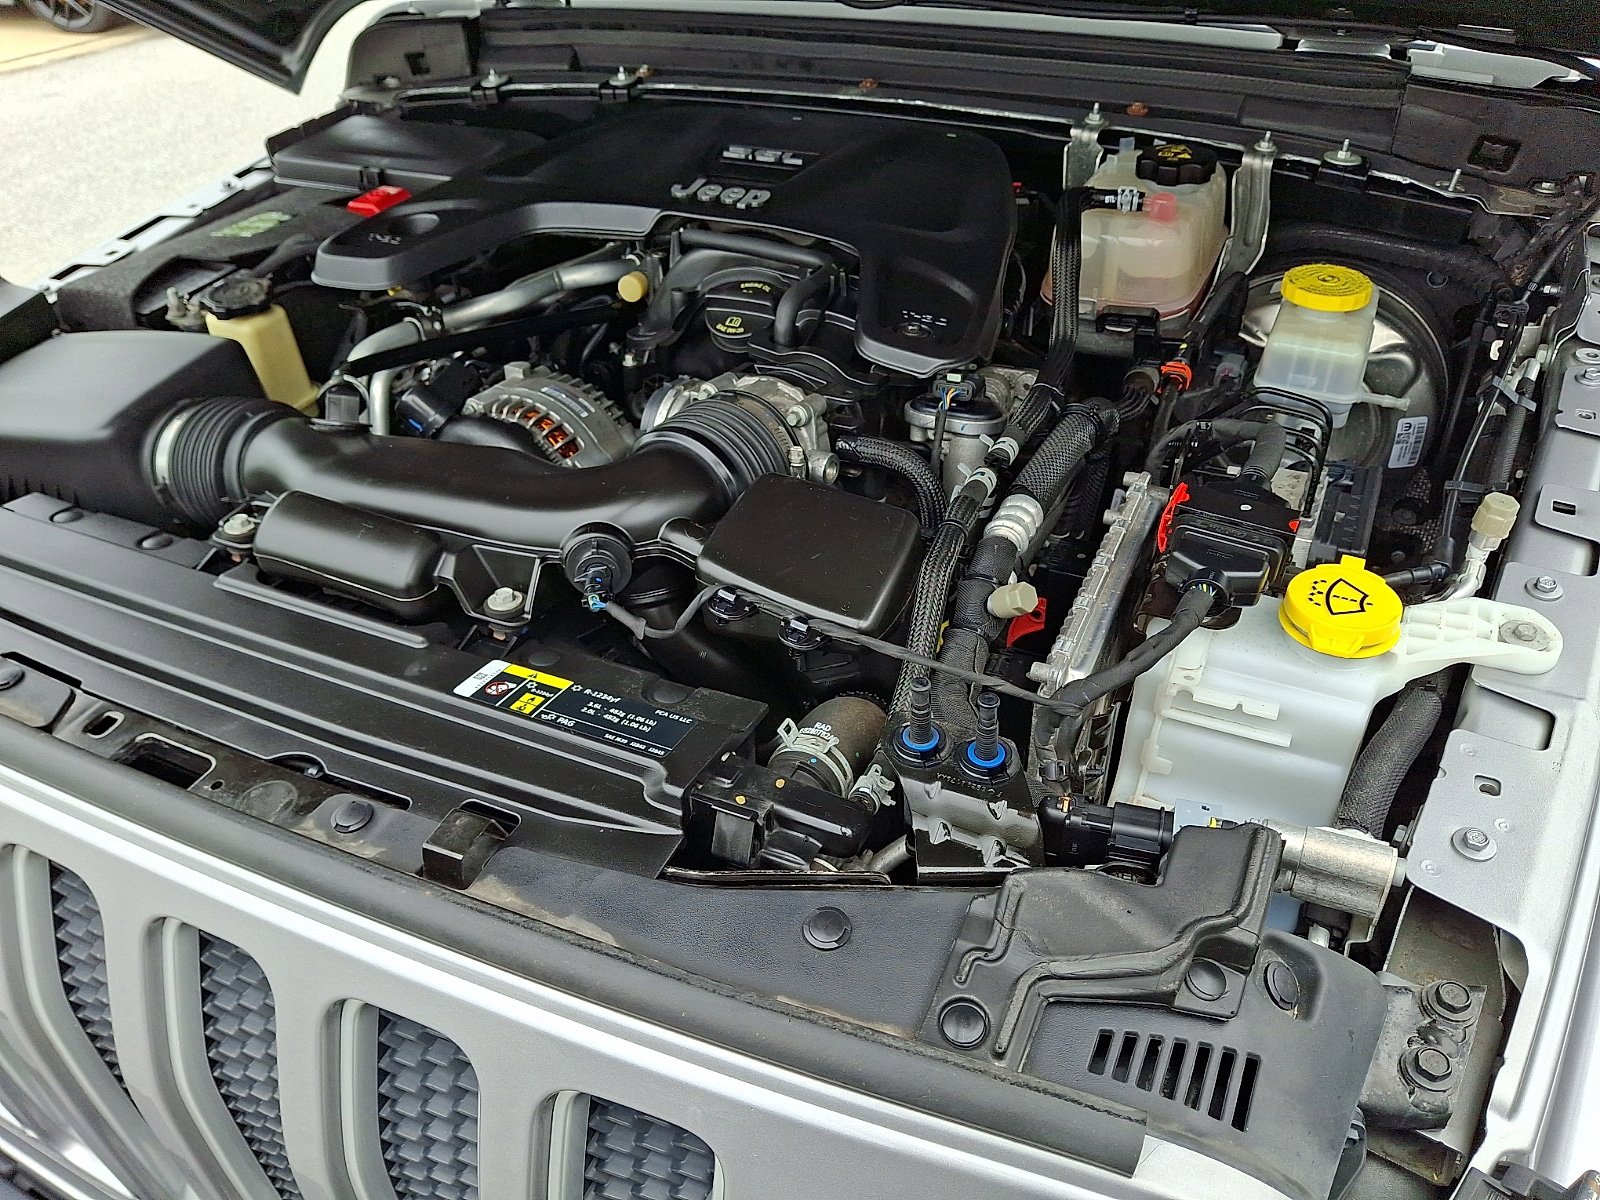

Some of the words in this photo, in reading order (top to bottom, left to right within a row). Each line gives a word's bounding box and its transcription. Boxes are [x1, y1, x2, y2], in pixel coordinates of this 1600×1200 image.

[670, 177, 772, 210] Jeep
[583, 688, 622, 703] R-1234yf
[557, 716, 576, 727] PAG
[654, 709, 669, 718] FCA
[679, 716, 693, 724] LLC
[814, 721, 832, 732] RAD
